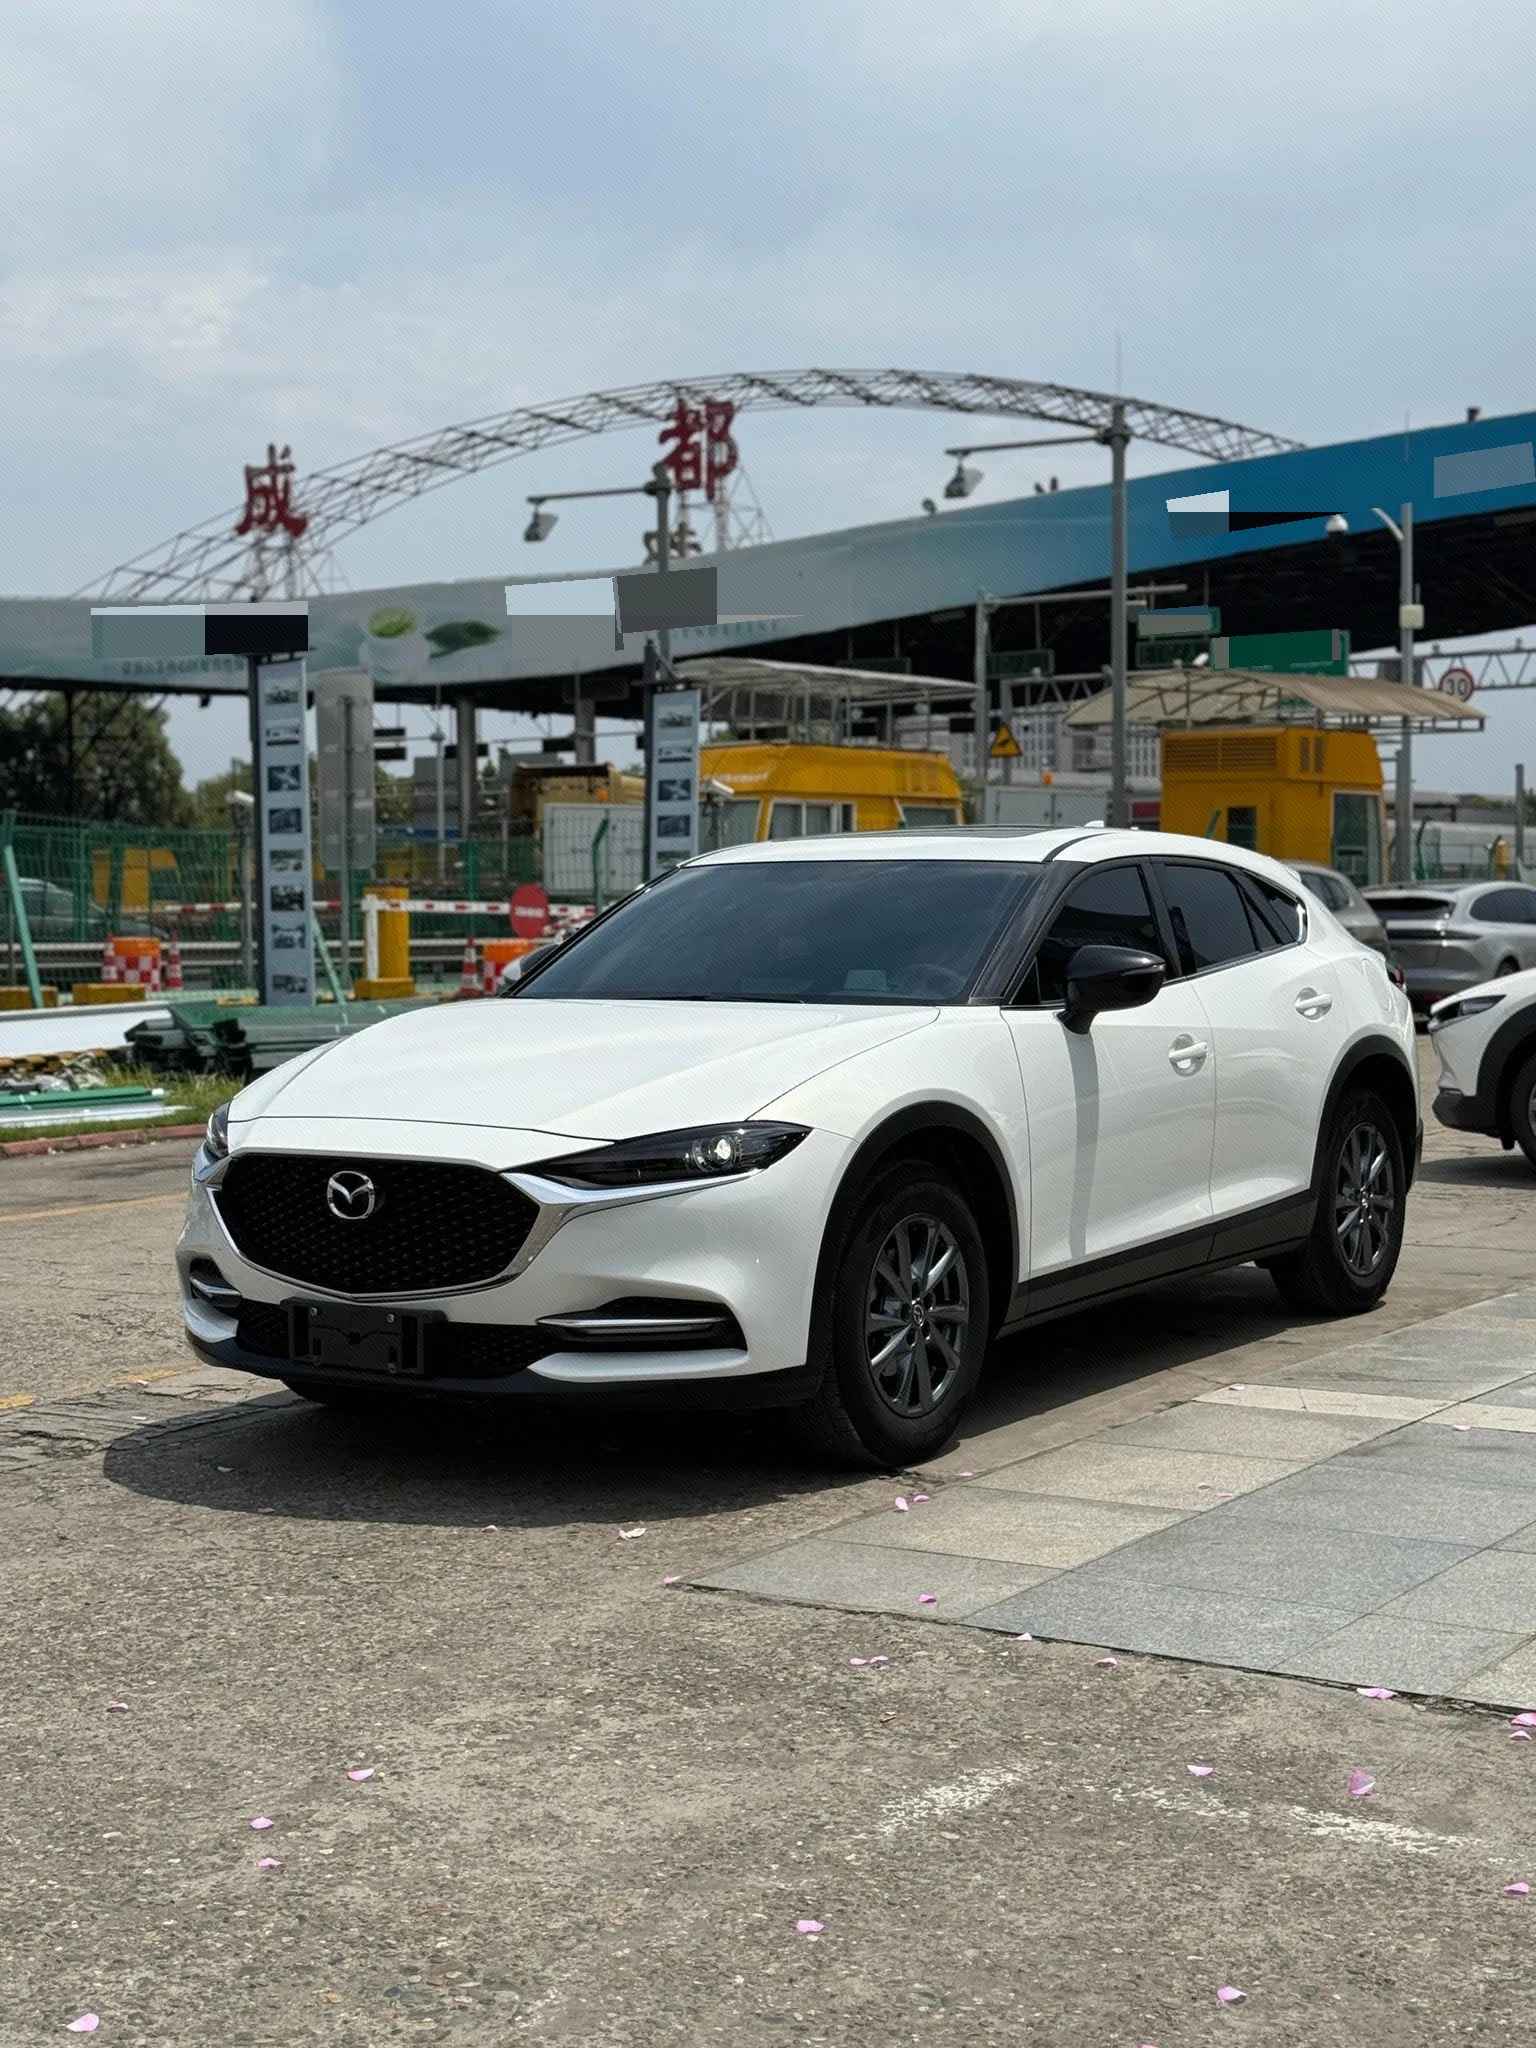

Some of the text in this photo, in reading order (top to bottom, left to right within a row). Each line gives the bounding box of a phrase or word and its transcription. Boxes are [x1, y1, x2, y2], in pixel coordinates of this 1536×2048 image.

[234, 398, 738, 537] 成 都
[1446, 678, 1468, 696] 30
